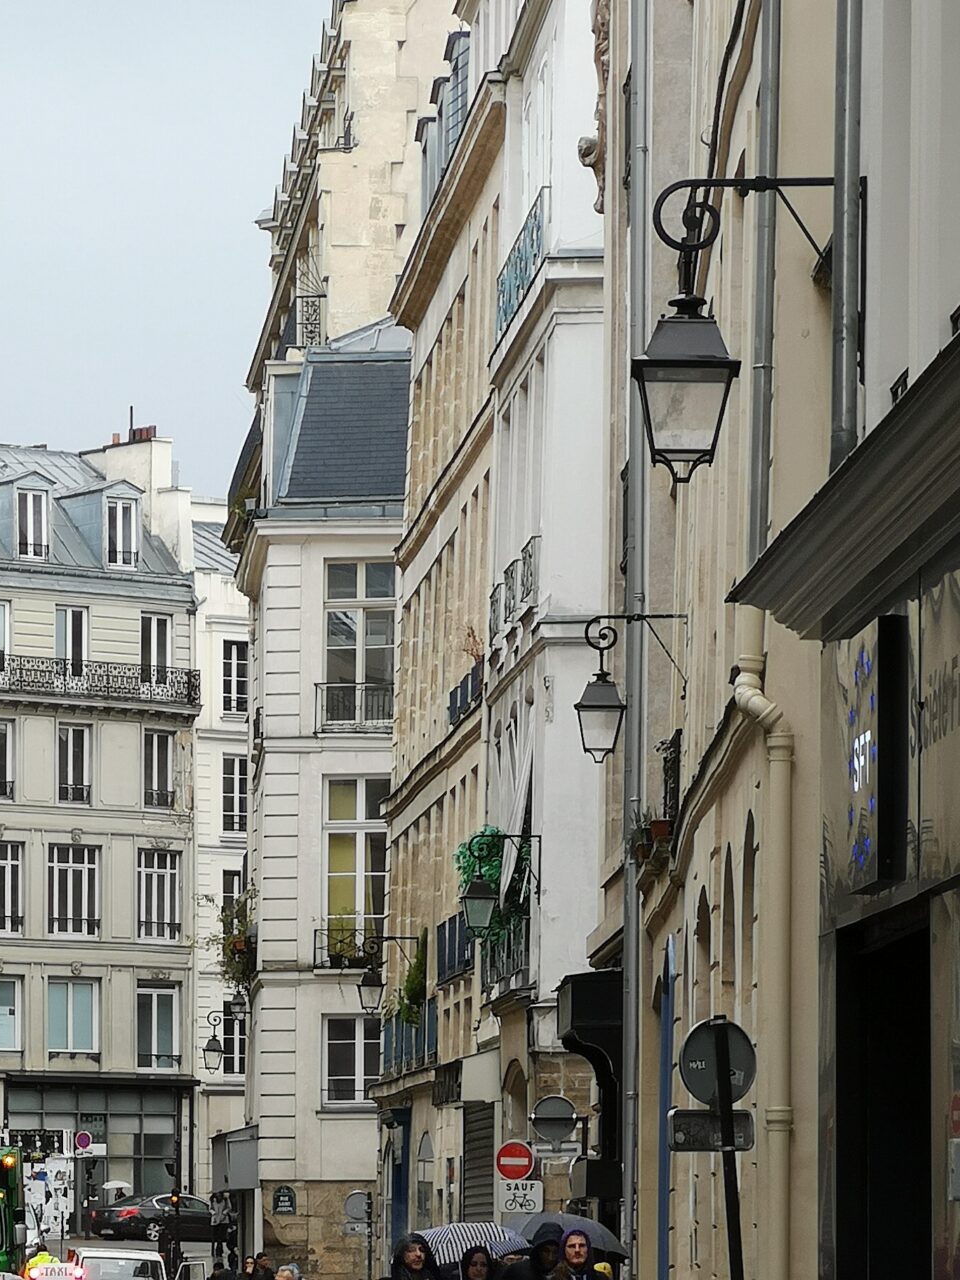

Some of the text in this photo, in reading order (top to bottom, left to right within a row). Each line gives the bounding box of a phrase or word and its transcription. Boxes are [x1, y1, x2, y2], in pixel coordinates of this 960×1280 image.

[853, 729, 872, 793] SFT
[506, 1182, 536, 1191] SAUF
[44, 1266, 68, 1277] TAXI
